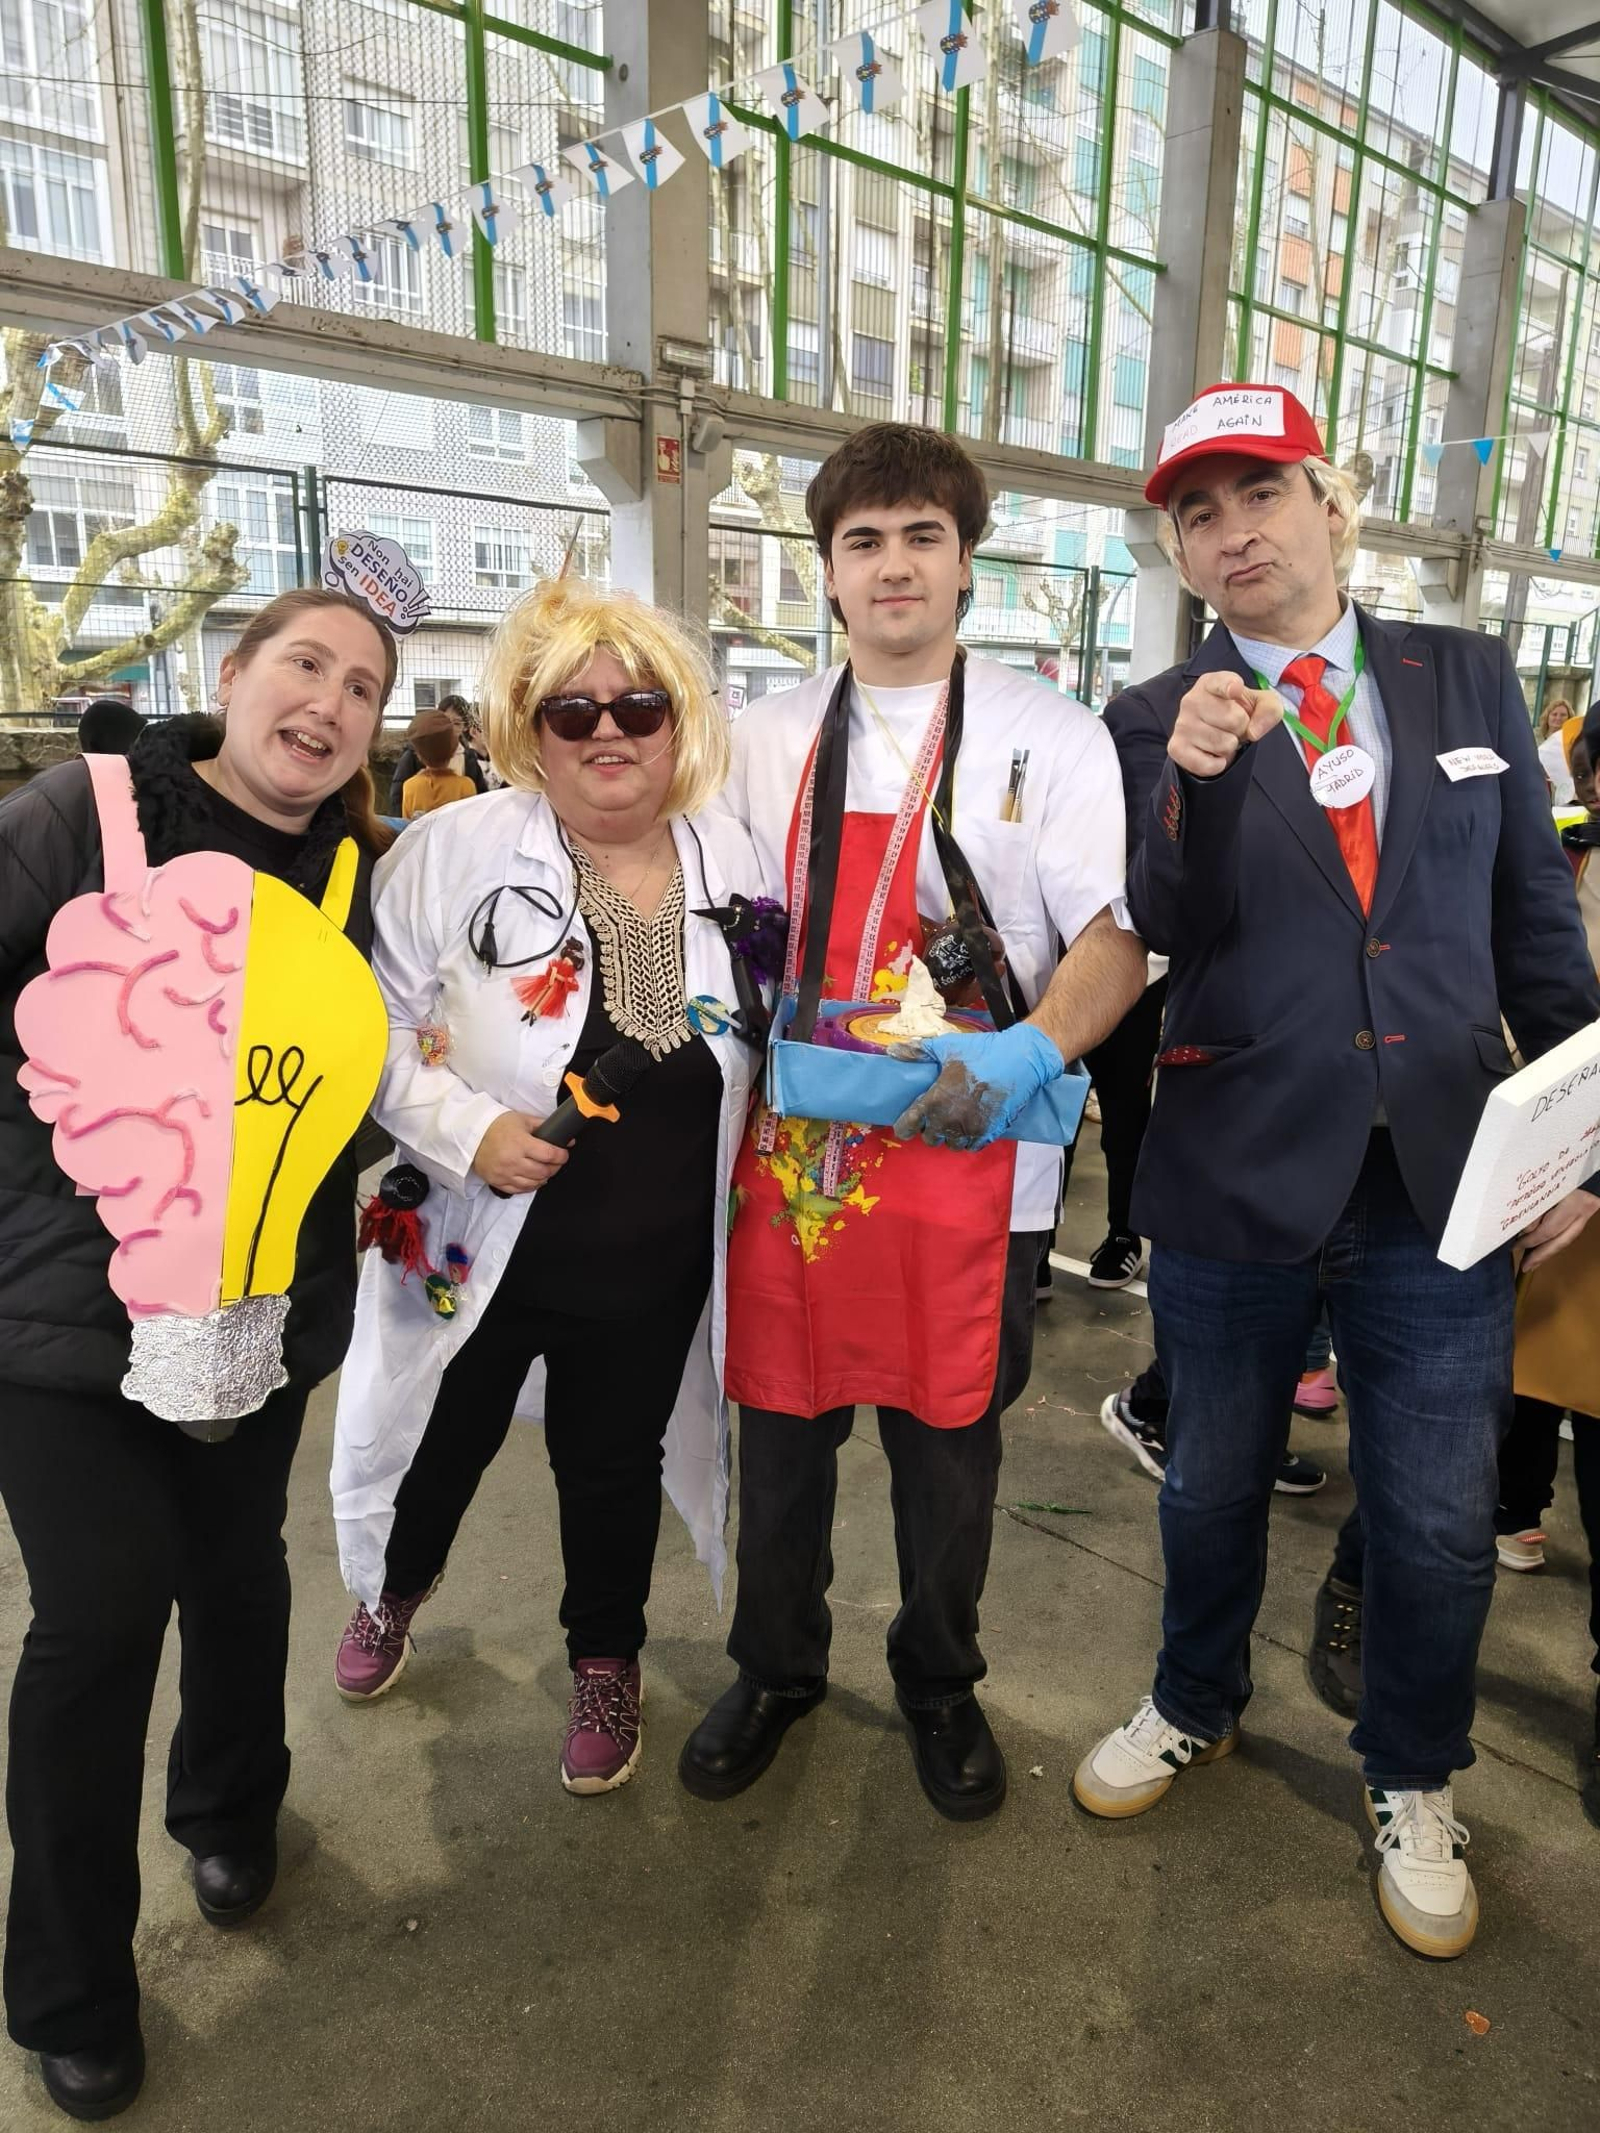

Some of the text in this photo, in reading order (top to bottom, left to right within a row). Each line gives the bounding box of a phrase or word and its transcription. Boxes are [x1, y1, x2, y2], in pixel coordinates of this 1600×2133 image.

[1217, 414, 1262, 430] AGAIN
[338, 556, 397, 617] sen IDEA
[351, 543, 408, 603] DESEÑO
[368, 540, 414, 588] Non hai
[1318, 749, 1354, 779] AYUSO
